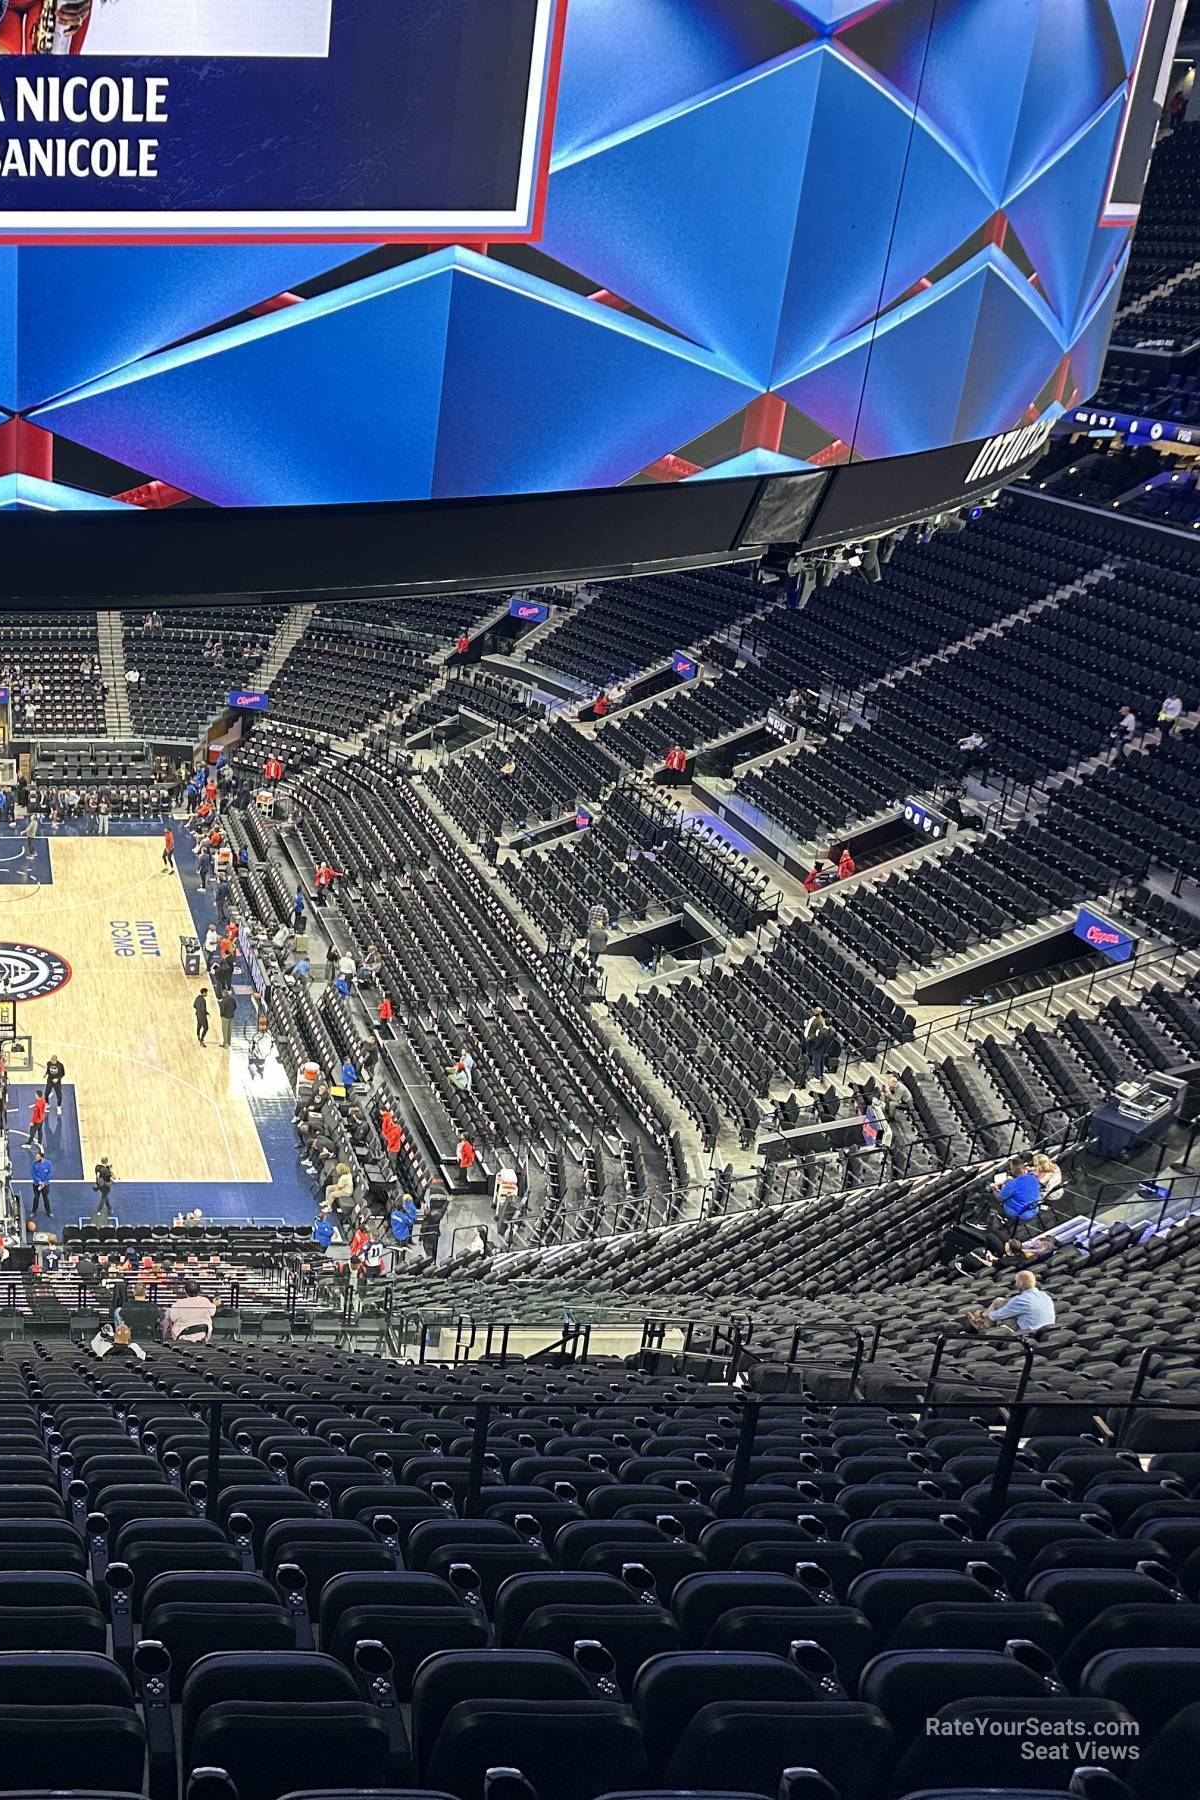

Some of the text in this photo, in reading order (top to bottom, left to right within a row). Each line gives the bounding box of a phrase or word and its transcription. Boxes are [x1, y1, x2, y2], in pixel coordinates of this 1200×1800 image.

[15, 76, 169, 122] NICOLE
[1087, 926, 1119, 944] Clippers
[14, 945, 65, 999] LOS ANGELES
